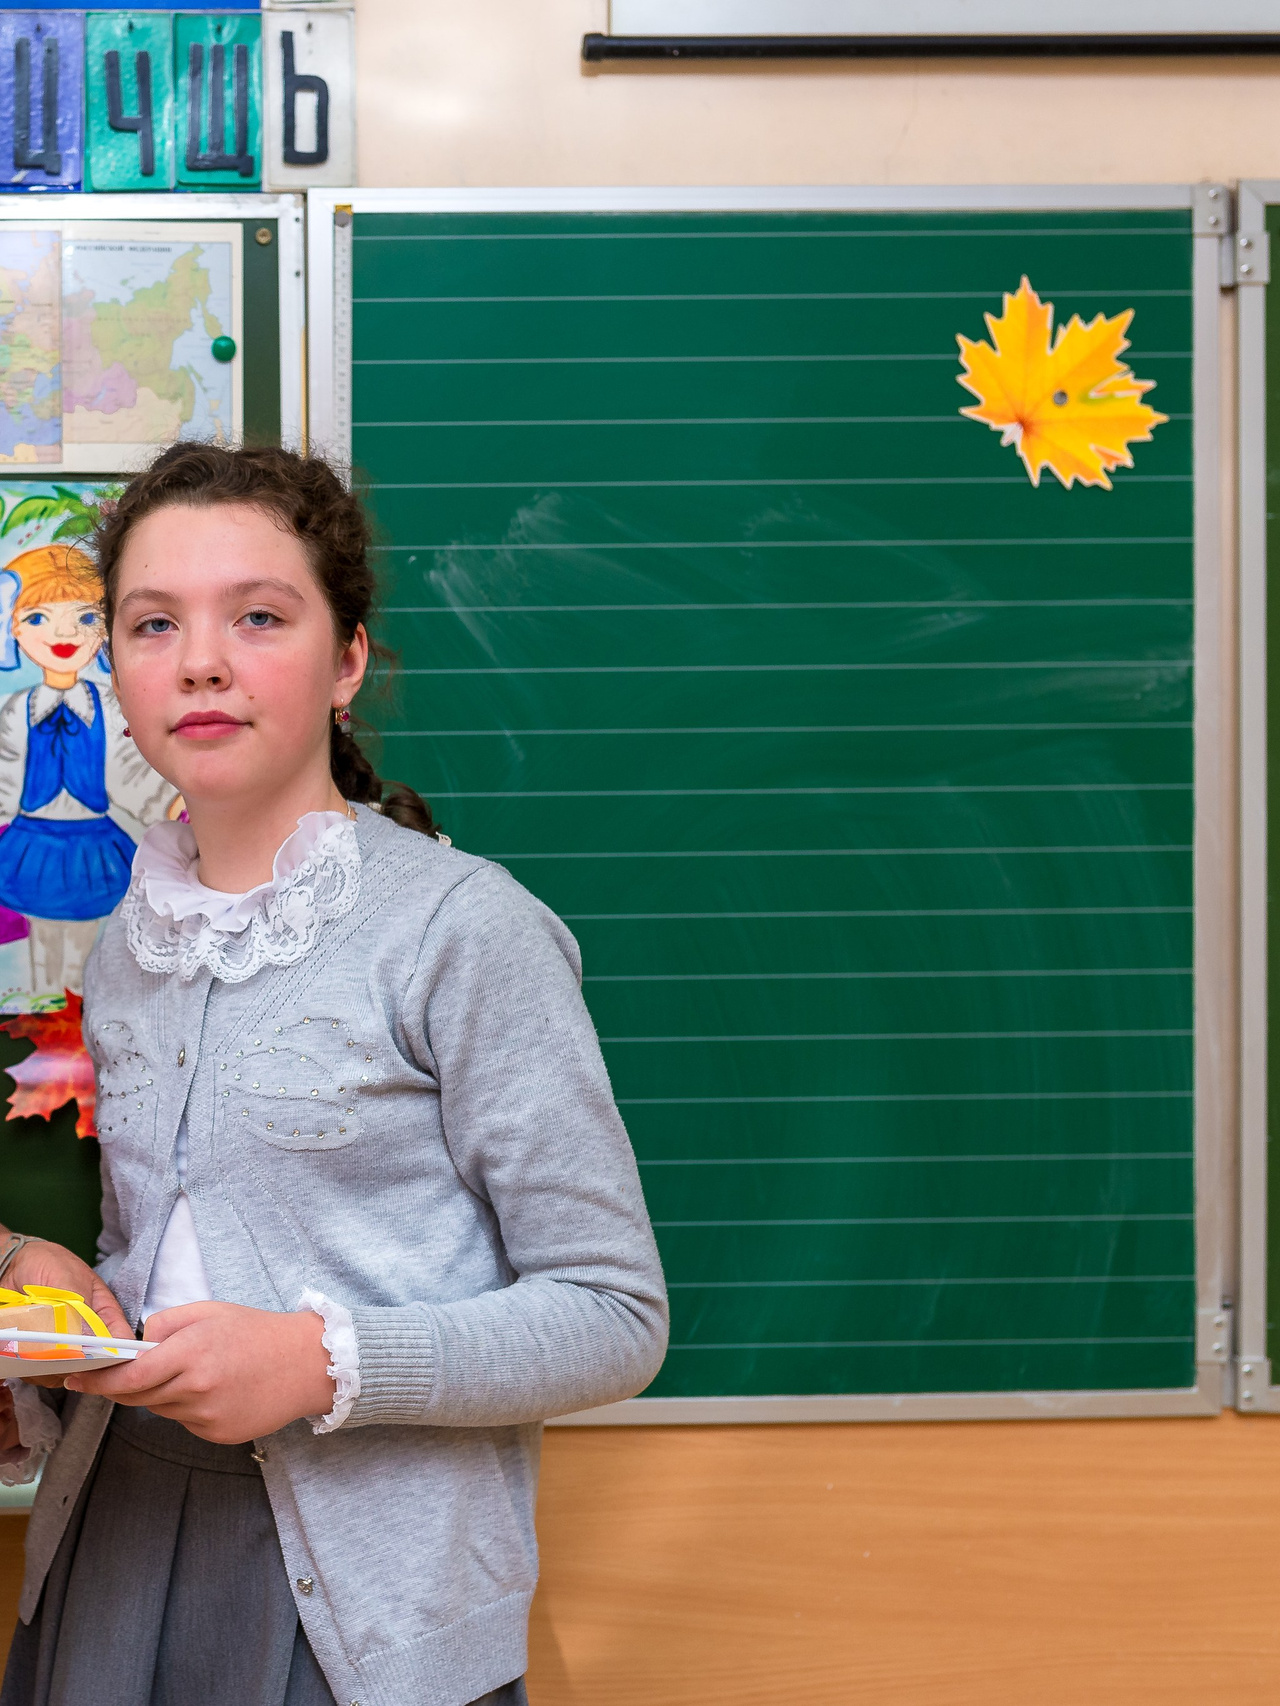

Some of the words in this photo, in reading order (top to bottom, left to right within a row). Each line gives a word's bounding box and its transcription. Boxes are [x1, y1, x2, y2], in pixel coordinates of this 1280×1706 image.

[14, 37, 62, 175] Ц
[105, 50, 154, 176] Ч
[186, 43, 253, 176] Щ
